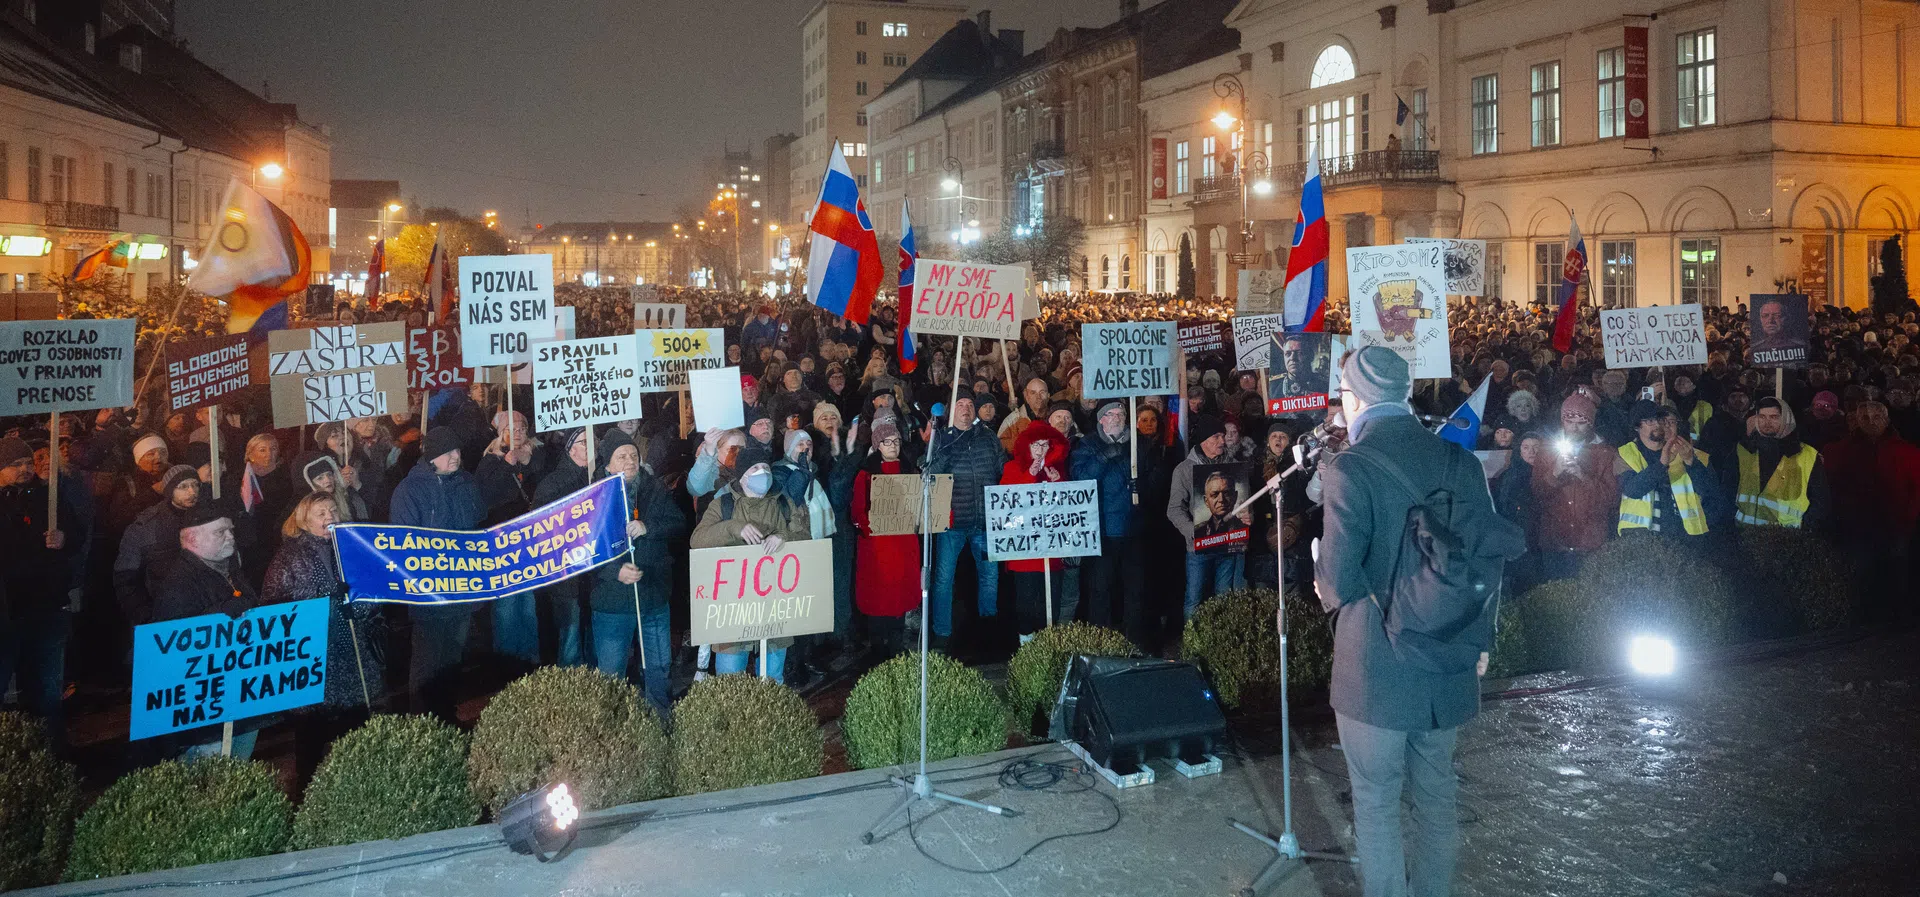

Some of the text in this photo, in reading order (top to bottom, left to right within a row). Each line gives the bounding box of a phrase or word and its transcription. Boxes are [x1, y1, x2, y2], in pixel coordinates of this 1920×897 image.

[1352, 251, 1394, 272] KTO
[1396, 246, 1439, 268] SOM?
[472, 270, 539, 293] POZVAL
[928, 264, 956, 286] MY
[958, 266, 997, 290] SME
[469, 295, 546, 325] NÁS SEM
[916, 288, 1015, 322] EURÓPA
[1607, 311, 1698, 330] CO ŠI O TEBE
[23, 329, 98, 346] ROZKLAD
[409, 326, 461, 356] EBY
[490, 331, 528, 355] FICO
[662, 337, 701, 353] 500+
[1100, 325, 1167, 346] SPOLOČNE
[1607, 328, 1701, 347] MYŠLI TVOJA
[0, 347, 122, 364] COVEJ OSOBNOSTI
[169, 338, 247, 378] SLOBODNÉ
[538, 342, 618, 362] SPRAVILI
[1108, 348, 1154, 365] PROTI
[1615, 344, 1695, 363] MAMKA?!!
[1753, 347, 1805, 364] STAČILO!!!
[17, 365, 102, 380] V PRIAMOM
[170, 358, 249, 394] SLOVENSKO
[563, 357, 596, 373] STE
[644, 357, 721, 373] PSYCHIATROV
[304, 370, 375, 401] ŠÍTE
[407, 367, 467, 389] UKOL
[536, 366, 634, 390] Z TATRANSKÉHO
[565, 381, 608, 396] TIGRA
[639, 371, 689, 388] SA NEMÔŽ
[1093, 367, 1170, 391] AGRESII!
[17, 385, 96, 404] PRENOSE
[172, 373, 249, 410] BEZ PUTINA
[541, 387, 631, 413] MŔTVU RYBU
[1282, 396, 1326, 410] DIKTUJEM
[549, 400, 626, 426] NA DUNAJI
[990, 488, 1023, 510] PÁR
[373, 498, 595, 553] ČLÁNOK 32 ÚSTAVY SR
[385, 522, 592, 572] + OBČIANSKY VZDOR
[403, 577, 484, 593] KONIEC
[490, 540, 598, 590] FICOVLÁDY
[695, 553, 801, 600] R. FICO
[705, 595, 816, 630] PUTINOV AGENT
[153, 604, 299, 654] VOJNOVÝ
[185, 636, 311, 679] ZLOČINEC
[146, 675, 225, 711] NIE JE
[172, 656, 323, 728] NÁŠ KAMOŠ
